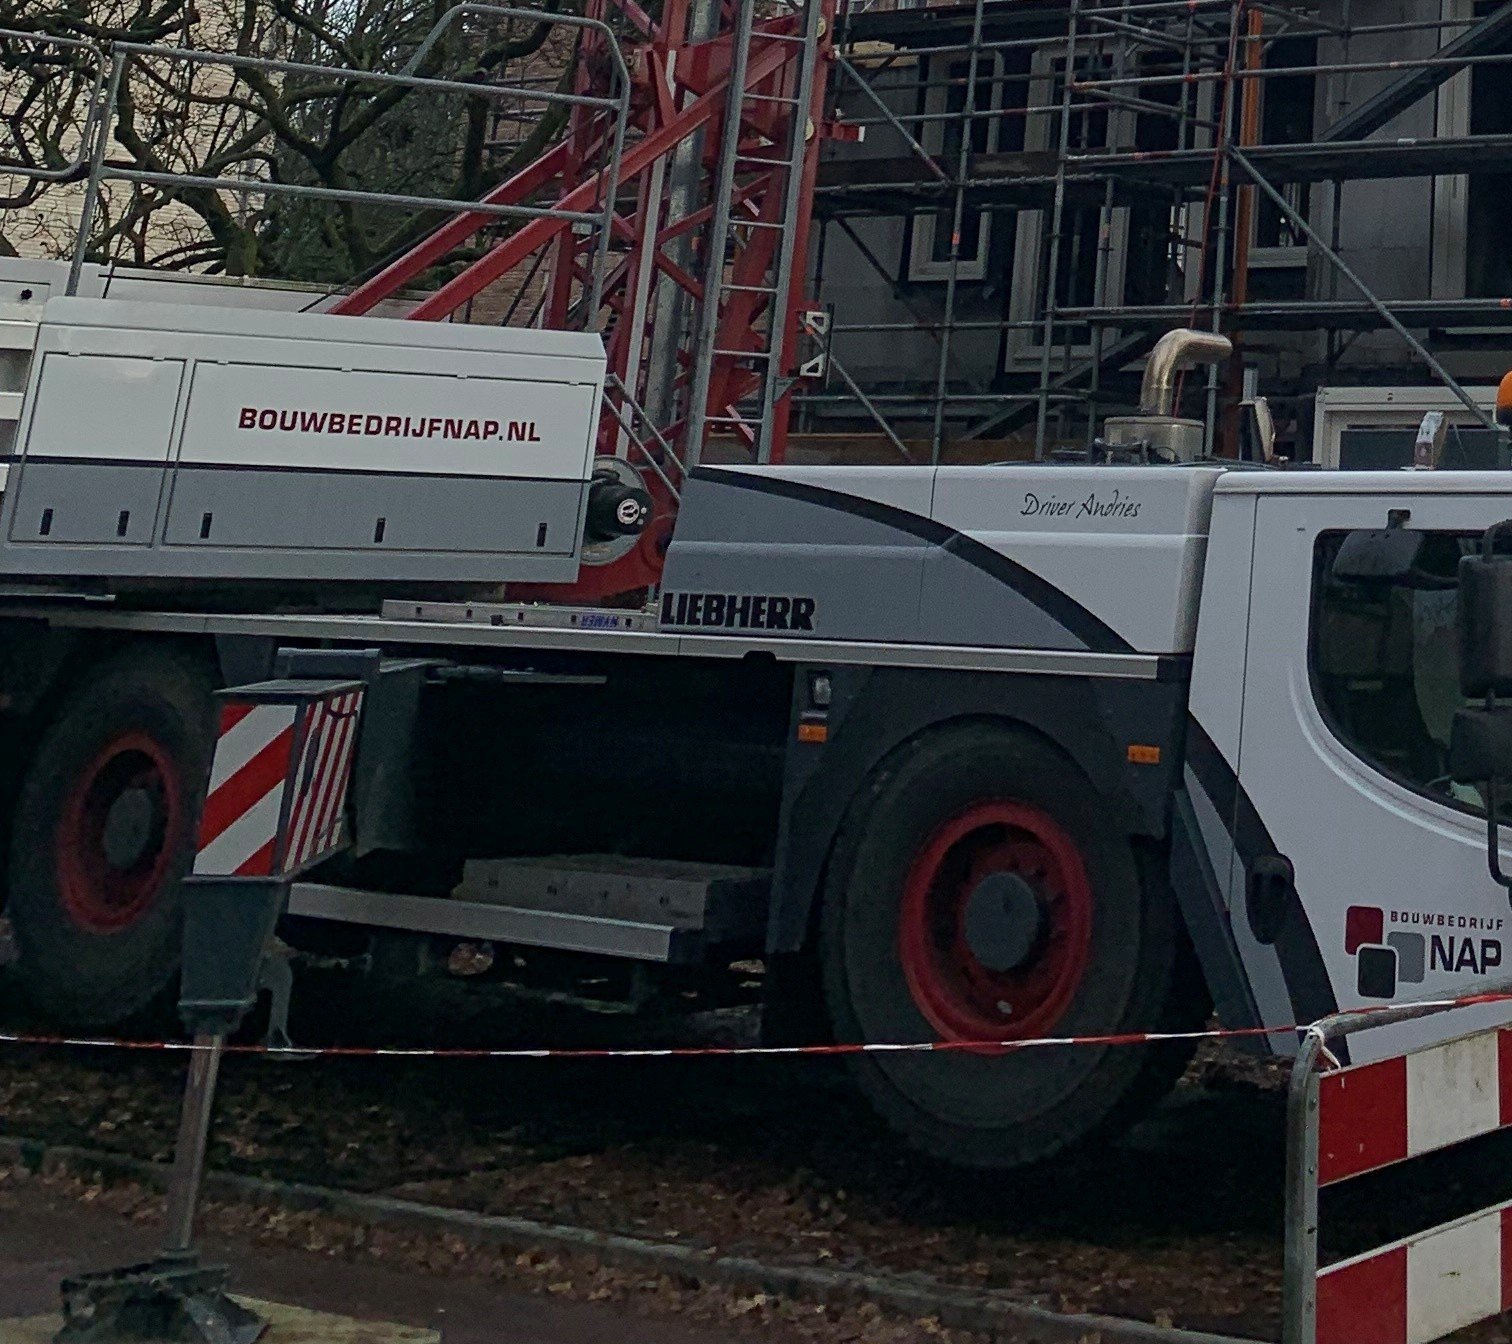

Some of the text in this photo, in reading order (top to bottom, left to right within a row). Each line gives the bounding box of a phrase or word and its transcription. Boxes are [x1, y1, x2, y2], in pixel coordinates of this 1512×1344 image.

[237, 406, 541, 443] BOUWBEDRIJFNAP.NL
[1019, 489, 1142, 520] Driver Andries
[660, 591, 815, 631] LIEBHERR
[1389, 909, 1505, 931] BOUWBEDRIJF
[1430, 934, 1503, 976] NAP
